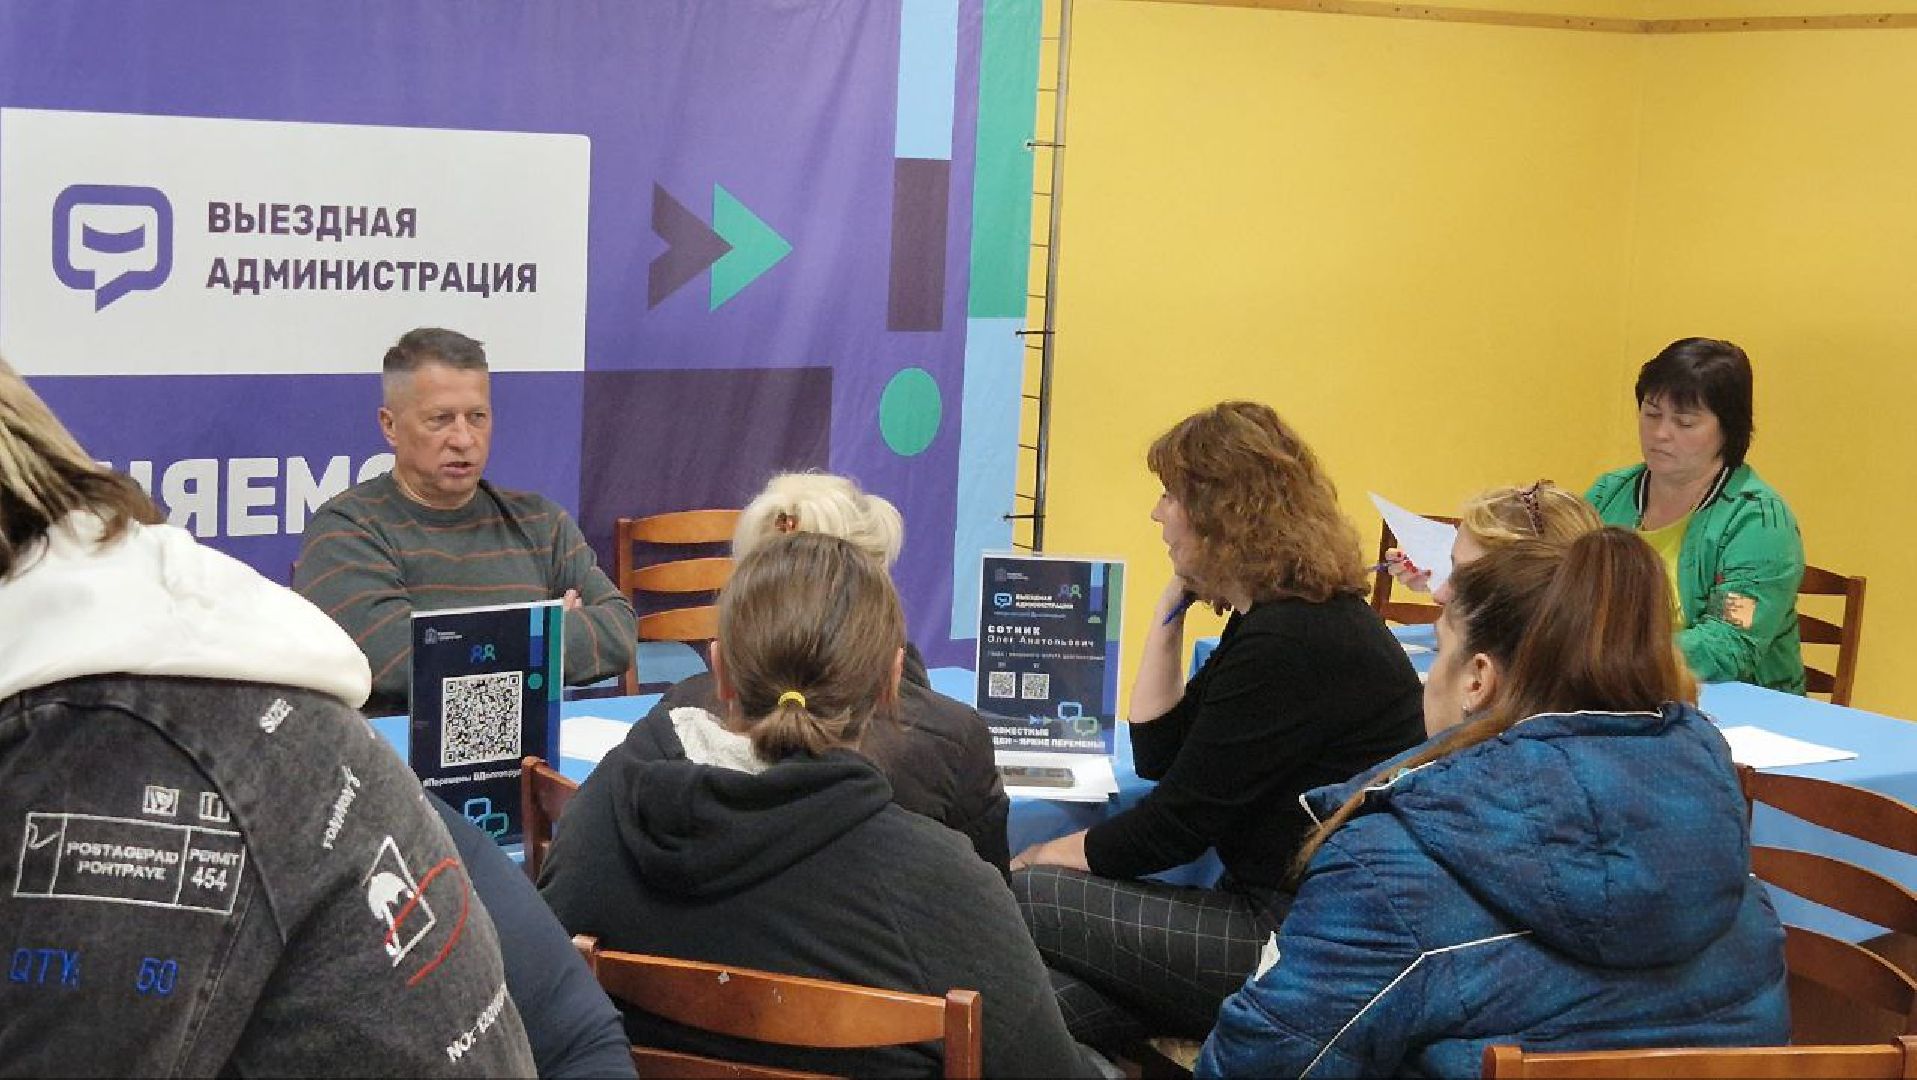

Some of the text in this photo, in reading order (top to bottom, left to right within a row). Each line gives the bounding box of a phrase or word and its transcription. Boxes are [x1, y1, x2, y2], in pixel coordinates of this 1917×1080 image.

[206, 201, 417, 241] ВЫЕЗДНАЯ
[206, 258, 538, 298] АДМИНИСТРАЦИЯ
[987, 625, 1041, 636] СОТНИК
[987, 634, 1013, 643] Олег
[190, 866, 227, 892] 454
[136, 956, 179, 995] 50
